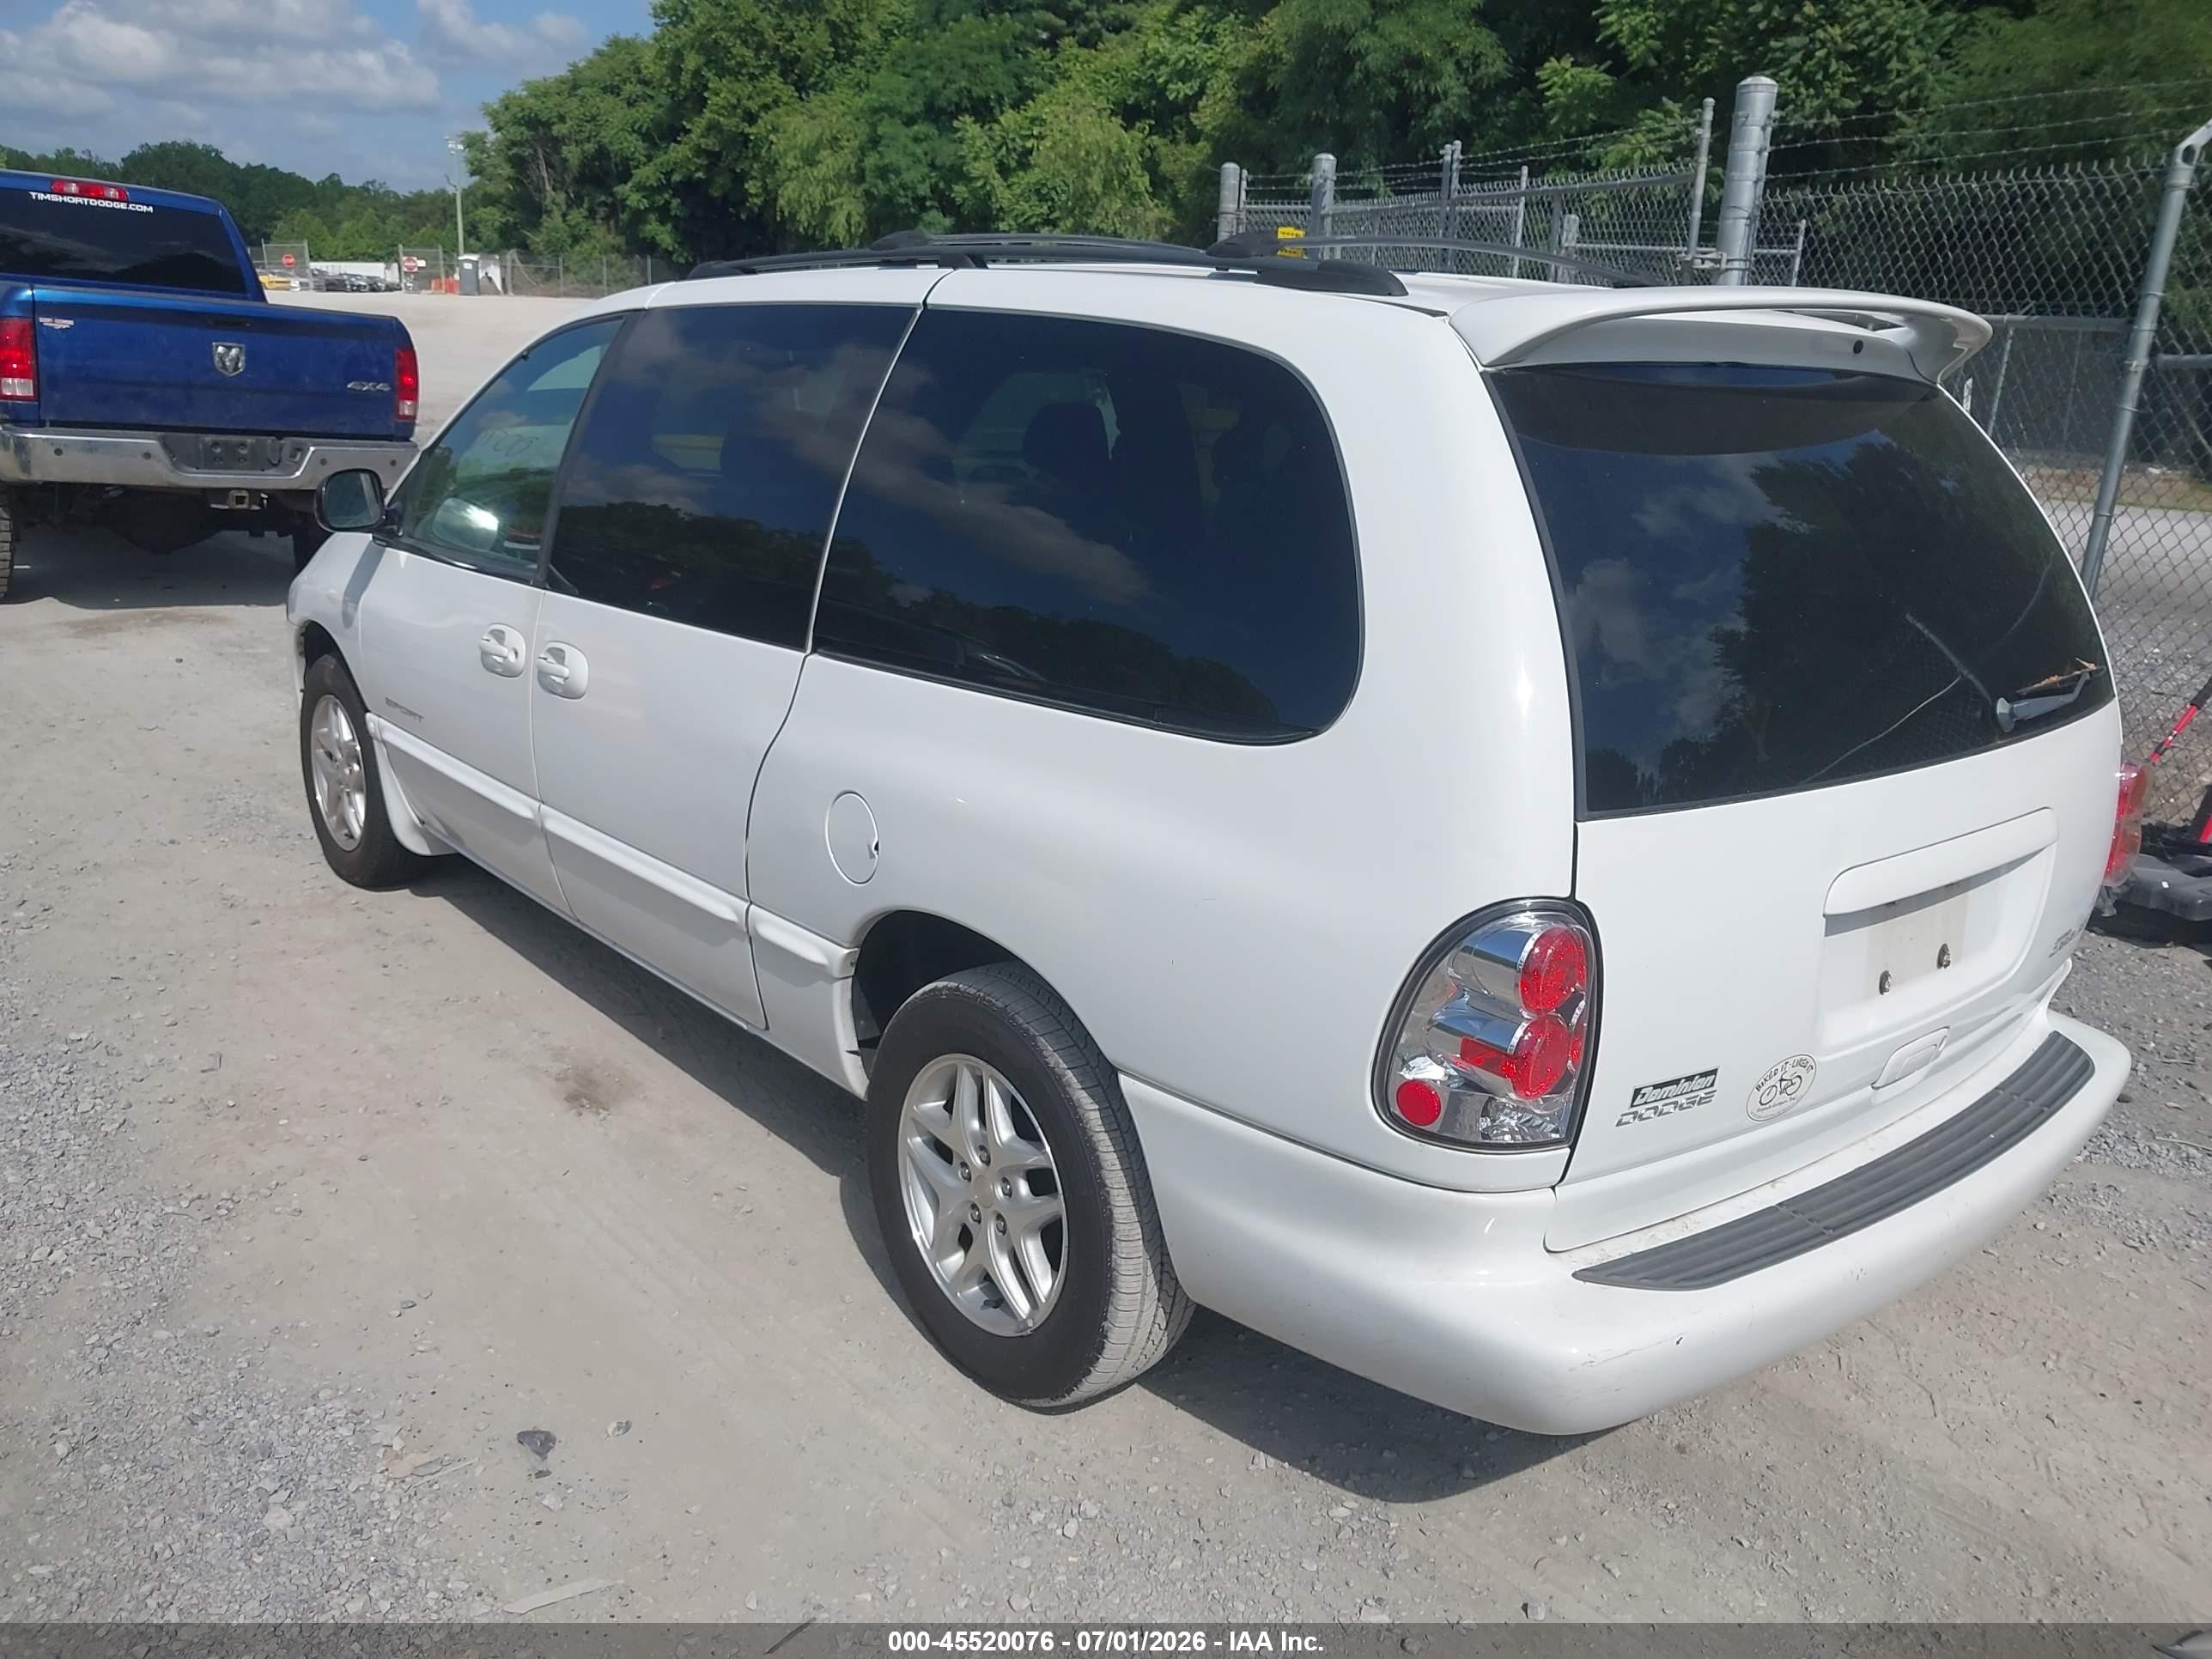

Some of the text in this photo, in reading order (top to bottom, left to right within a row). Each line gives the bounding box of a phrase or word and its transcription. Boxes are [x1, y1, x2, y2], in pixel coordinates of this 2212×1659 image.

[29, 191, 154, 214] TIMSHORTDODGE.COM
[1632, 1074, 1716, 1105] Dominion
[1755, 1068, 1778, 1092] BIKED
[1615, 1089, 1717, 1127] DODGE
